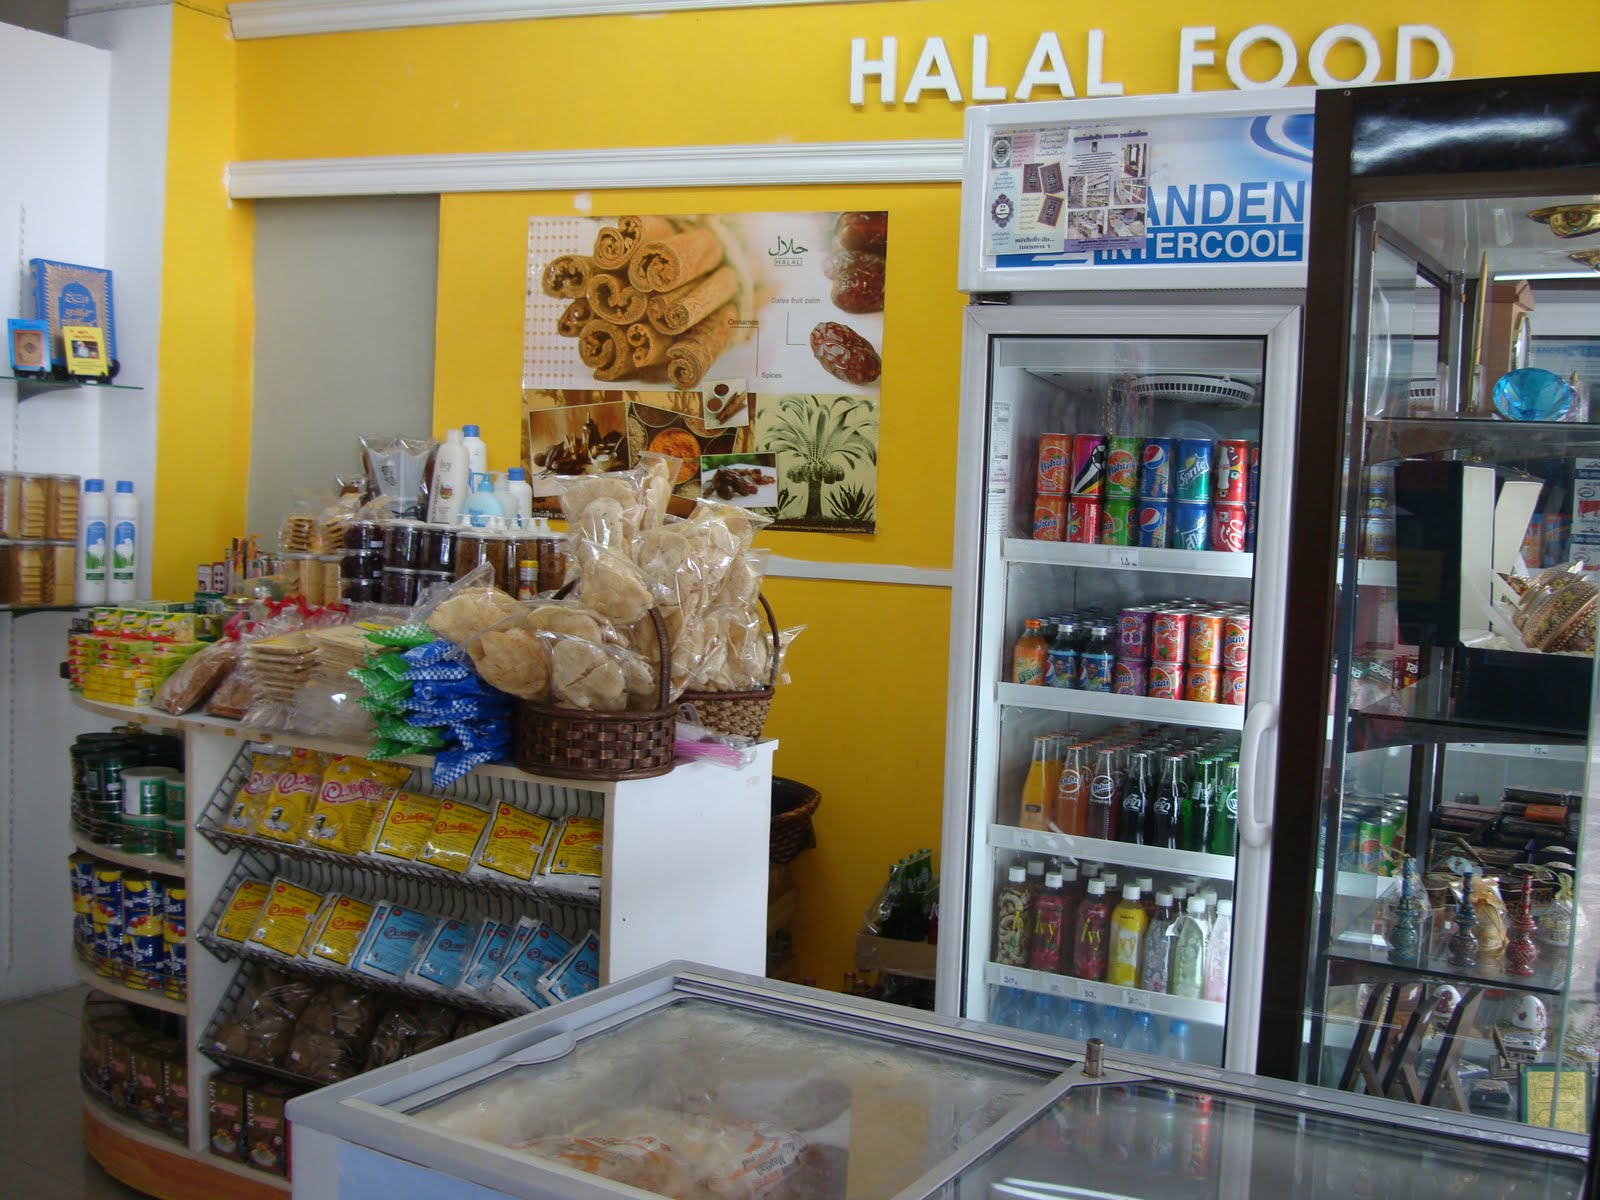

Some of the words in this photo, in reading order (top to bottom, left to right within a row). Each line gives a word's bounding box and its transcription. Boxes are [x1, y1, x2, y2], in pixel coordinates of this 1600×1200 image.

[849, 29, 1124, 106] HALAL
[1178, 24, 1455, 91] FOOD
[768, 235, 809, 257] حلال
[804, 297, 821, 305] palm
[727, 318, 759, 326] Cinnamon
[1179, 456, 1209, 487] Sprite
[208, 1081, 217, 1113] KOPI
[247, 1094, 256, 1127] KOPI
[754, 1153, 787, 1177] Meatball
